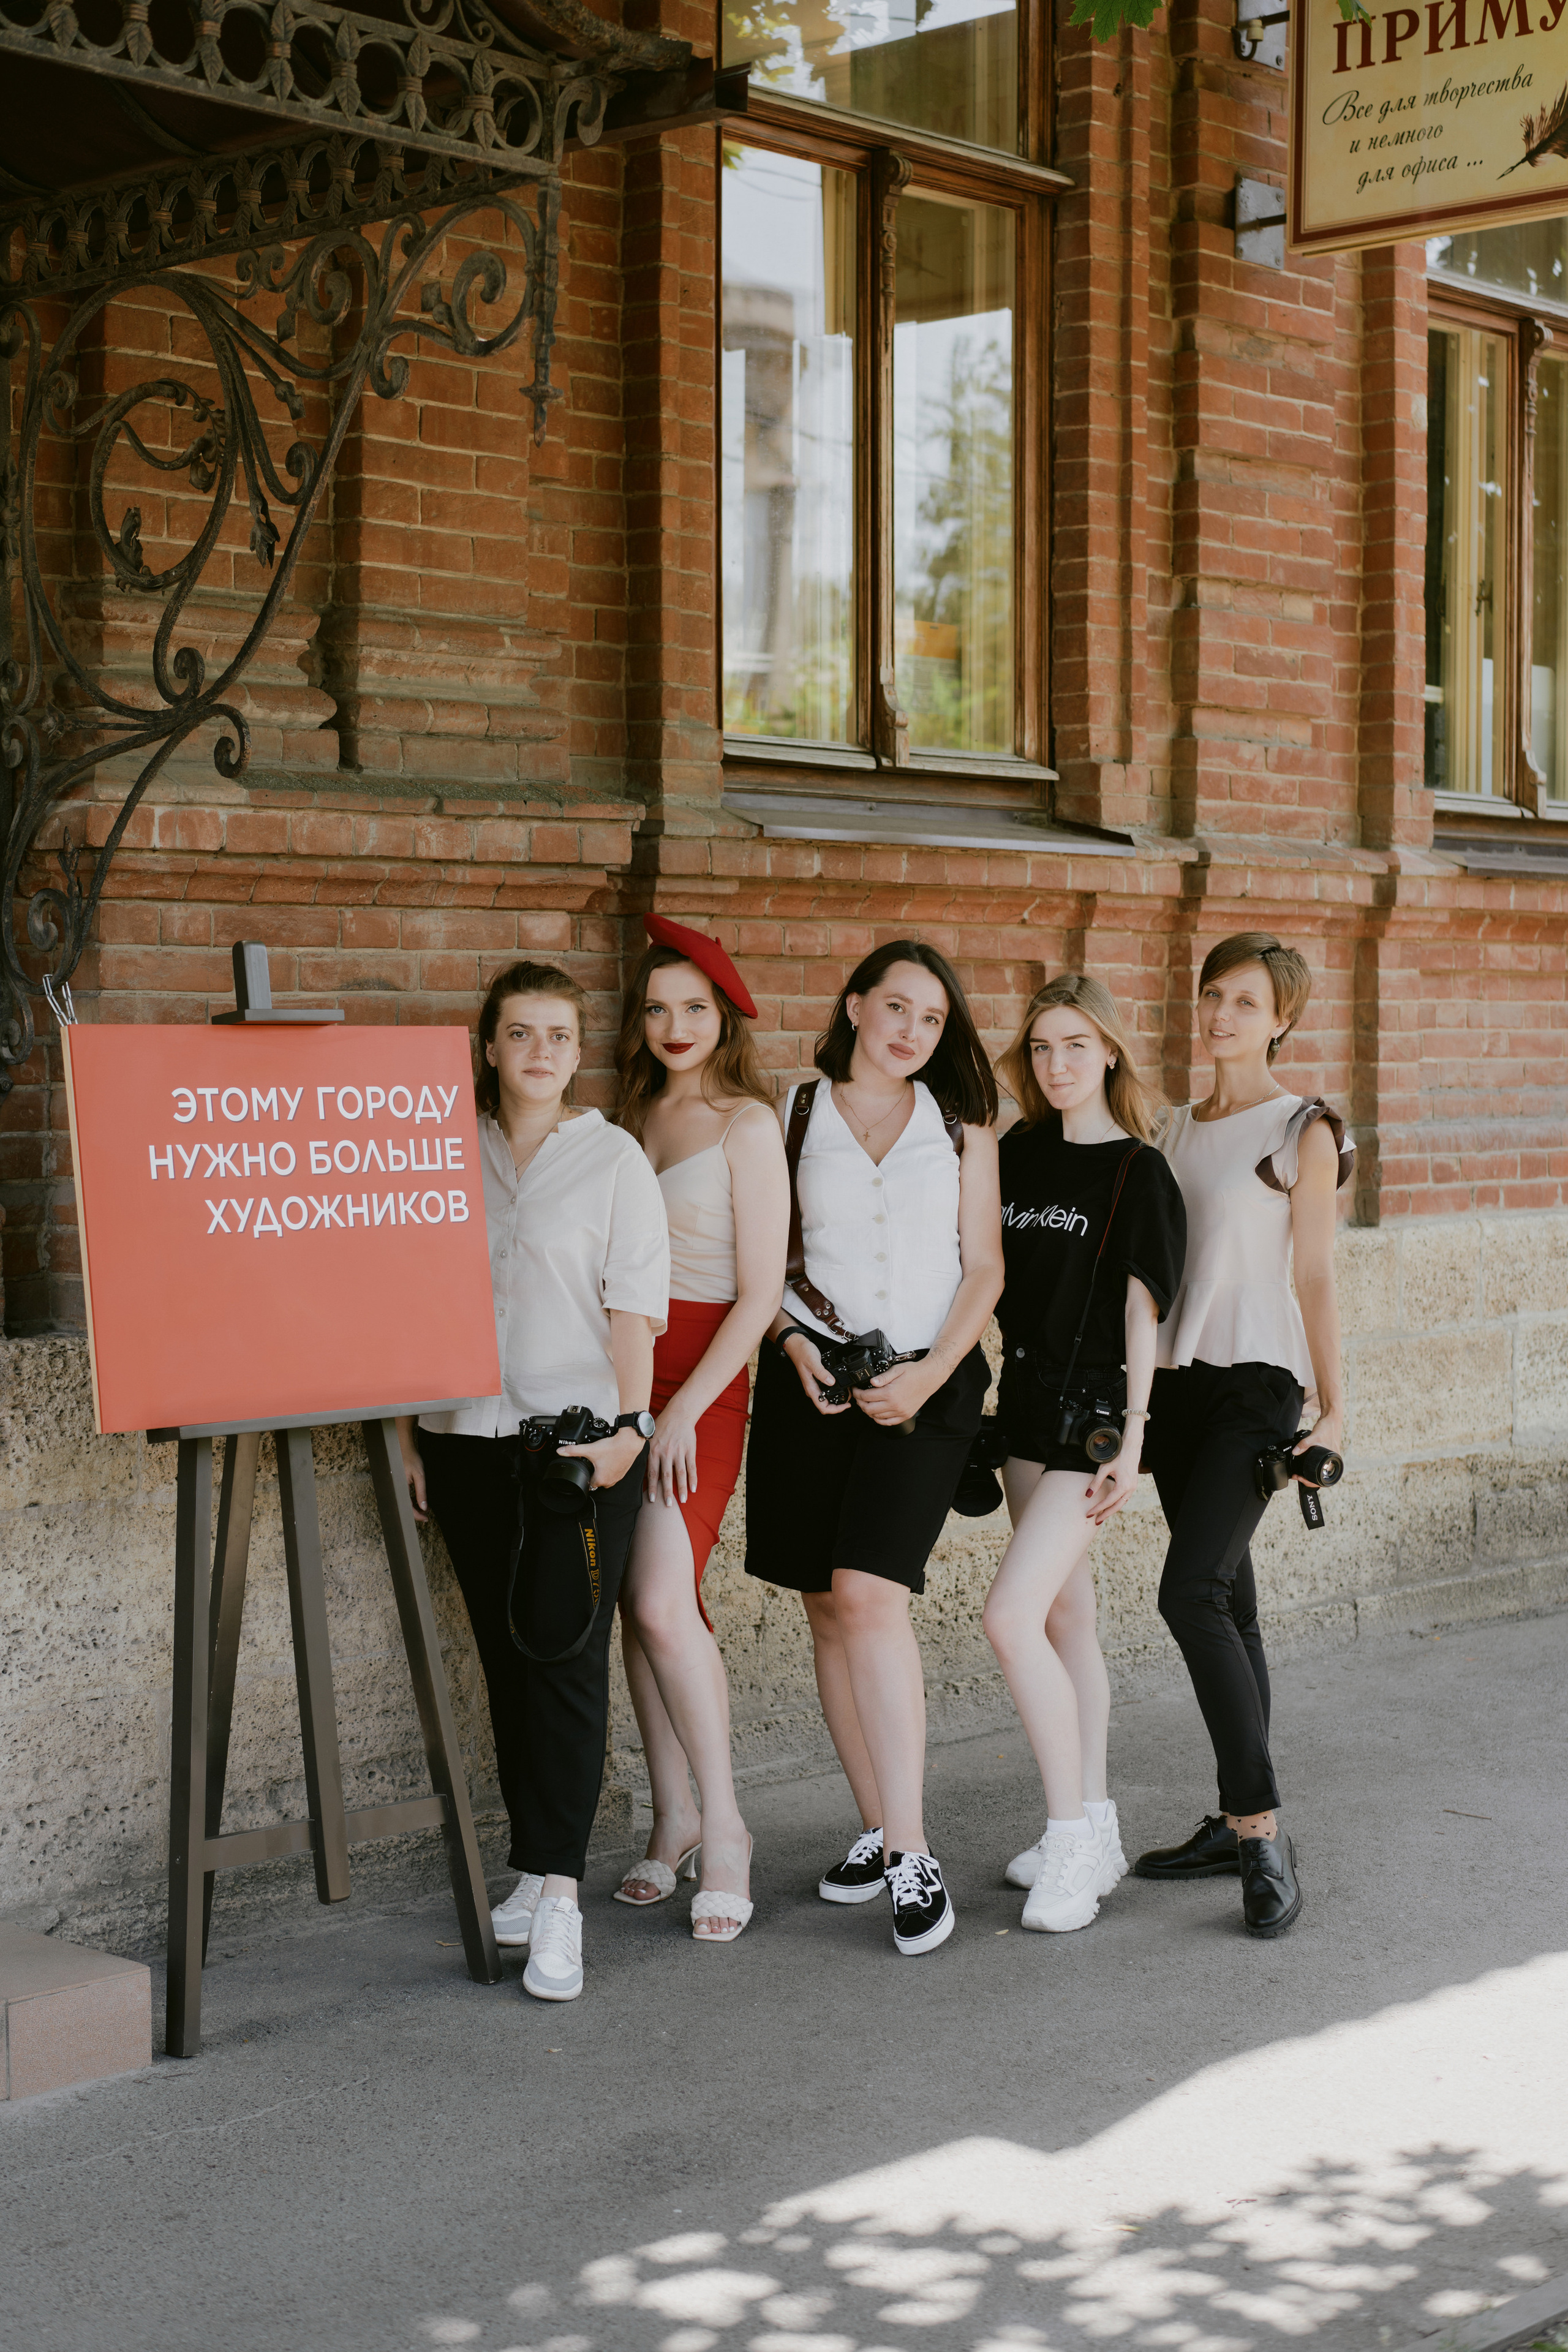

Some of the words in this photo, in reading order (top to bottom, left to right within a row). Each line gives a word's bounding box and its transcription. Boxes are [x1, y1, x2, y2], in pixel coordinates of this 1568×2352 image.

[1322, 90, 1373, 125] Все
[1378, 95, 1417, 124] для
[1423, 64, 1534, 109] творчества
[1349, 139, 1361, 154] и
[1367, 124, 1444, 151] немного
[1356, 167, 1395, 194] для
[1401, 156, 1458, 184] офиса
[171, 1087, 304, 1123] ЭТОМУ
[317, 1085, 459, 1125] ГОРОДУ
[148, 1141, 296, 1180] НУЖНО
[309, 1137, 465, 1174] БОЛЬШЕ
[205, 1189, 469, 1238] ХУДОЖНИКОВ
[1307, 1494, 1317, 1520] SONY
[584, 1529, 596, 1566] Nikon
